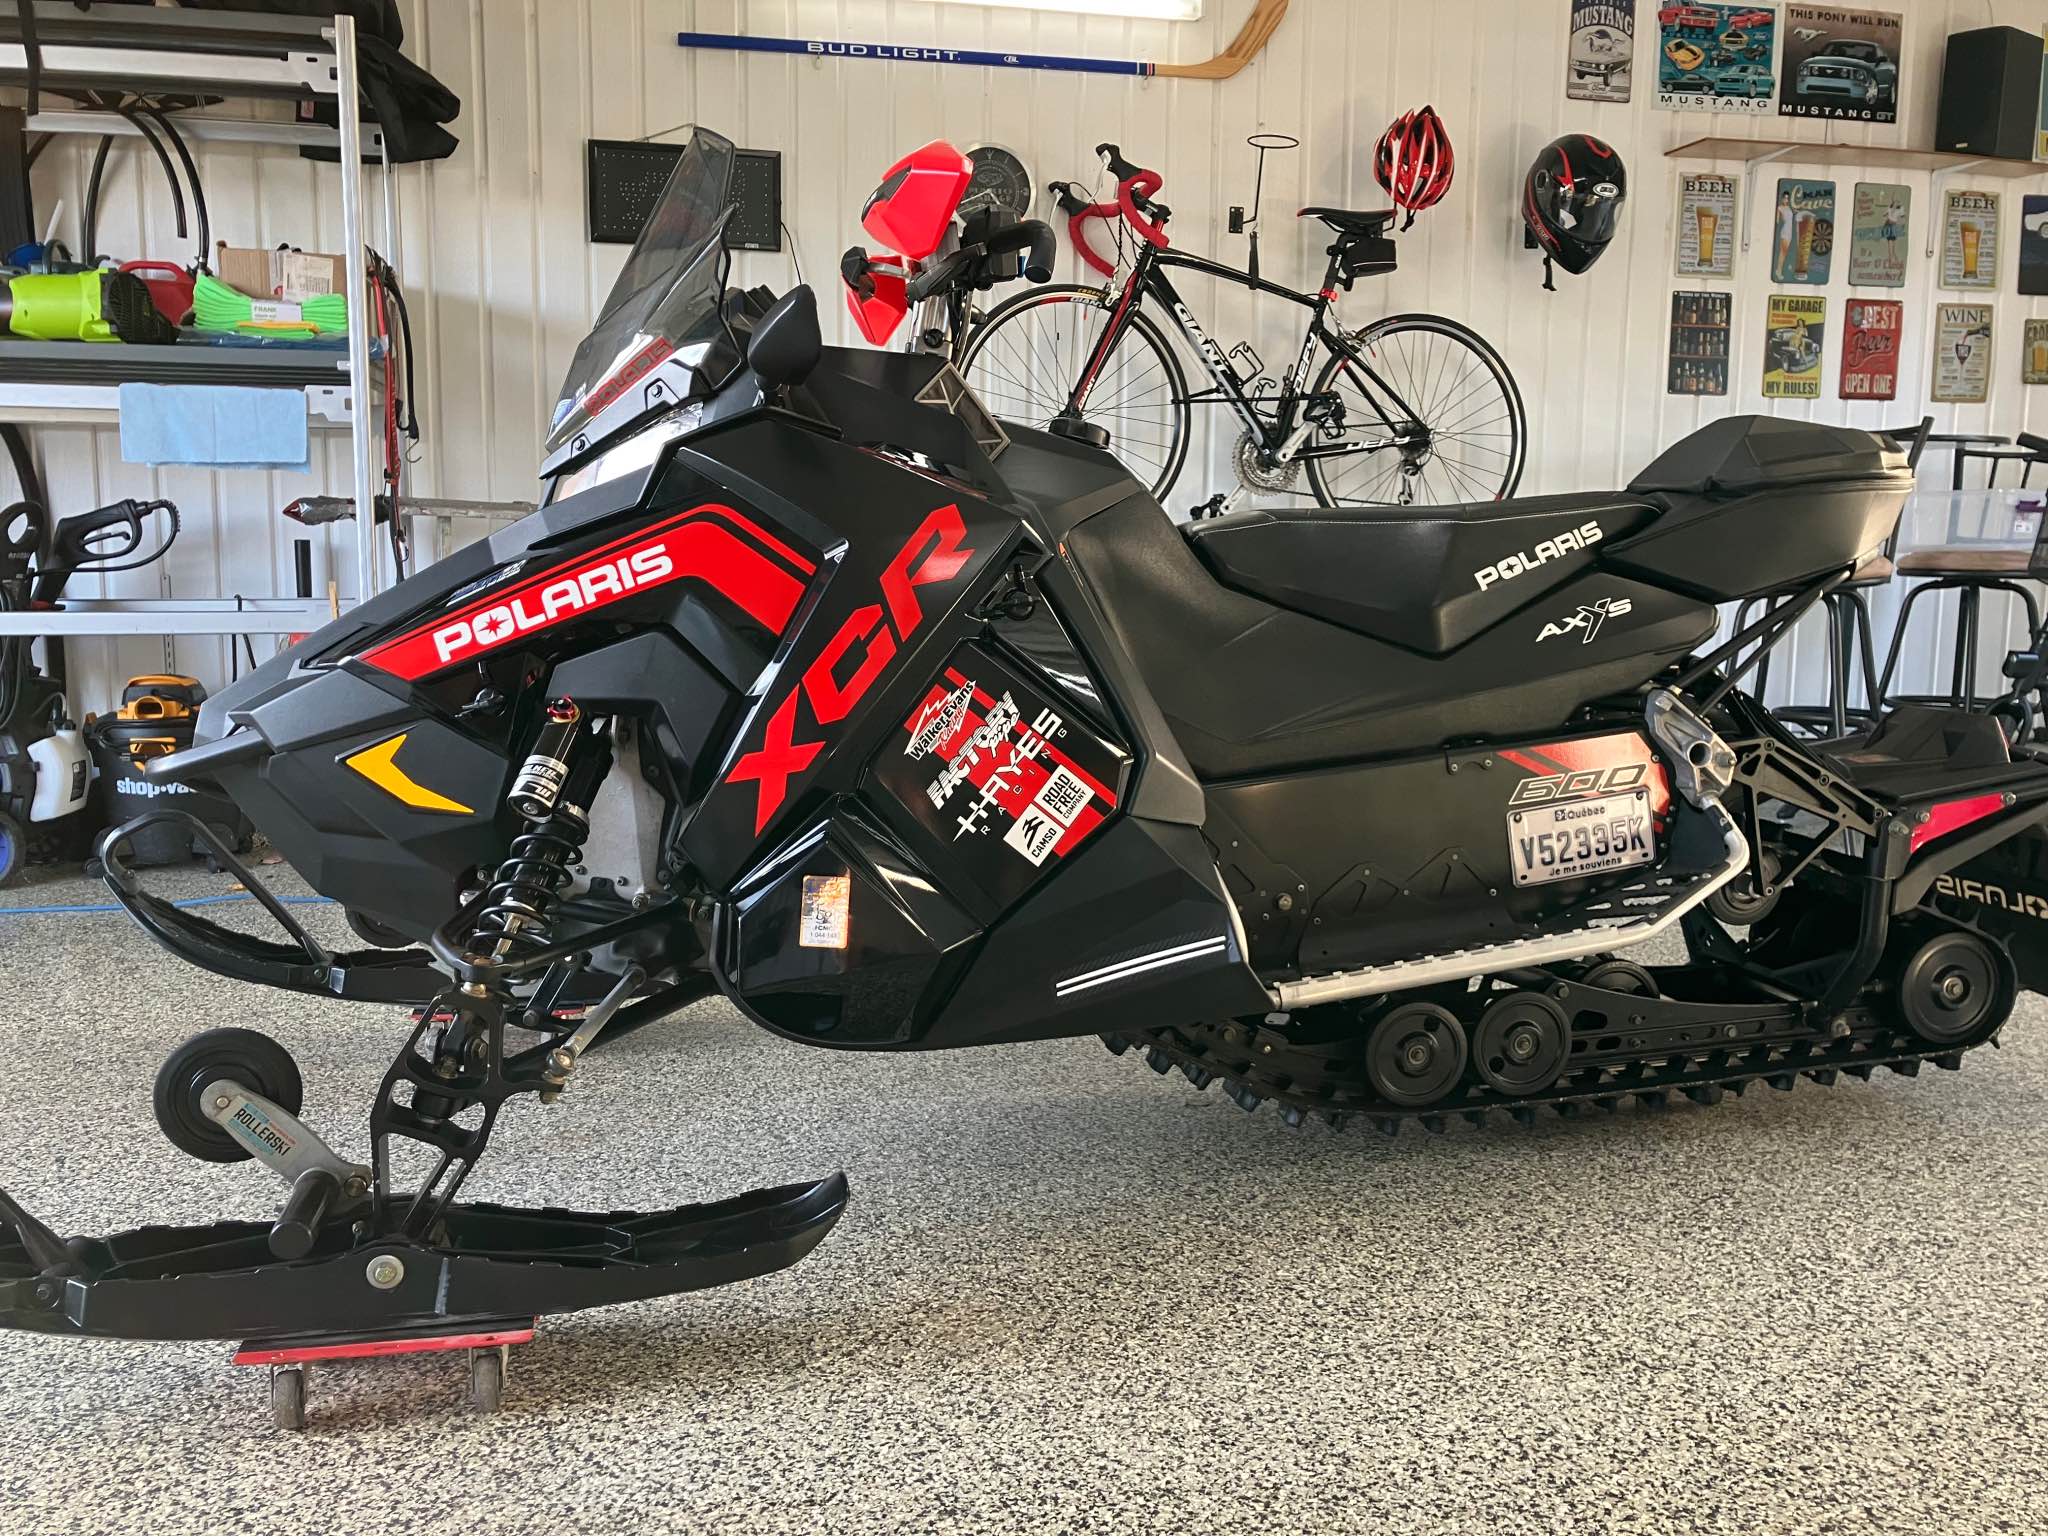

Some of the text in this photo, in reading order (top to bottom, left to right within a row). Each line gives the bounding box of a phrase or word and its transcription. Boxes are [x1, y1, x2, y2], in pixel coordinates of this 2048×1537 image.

[1573, 5, 1633, 35] MUSTANG
[1790, 9, 1899, 28] THIS PONY WILL RUN
[807, 42, 959, 61] BUD LIGHT
[1661, 95, 1768, 108] MUSTANG
[1782, 104, 1894, 121] MUSTANG GT
[1685, 181, 1733, 194] BEER
[1790, 184, 1833, 210] Cave
[1951, 196, 1995, 209] BEER
[1772, 298, 1823, 313] MY GARAGE
[1864, 305, 1899, 330] BEST
[1945, 309, 1987, 323] WINE
[1174, 301, 1232, 377] GIANT
[586, 340, 670, 412] POLARIS
[1293, 332, 1317, 394] DEFY
[1077, 376, 1096, 411] GIANT
[1766, 381, 1818, 395] MY RULES!
[1845, 373, 1893, 394] OPEN ONE
[1474, 520, 1604, 592] POLARIS
[432, 543, 673, 663] POLARIS
[1535, 597, 1632, 644] AXYS
[725, 503, 976, 838] XCR
[910, 680, 975, 760] Walker Evans
[926, 690, 1020, 810] FACTORY
[953, 707, 1062, 842] HAYES
[1042, 773, 1071, 806] ROAD
[1509, 763, 1648, 805] 600
[1053, 781, 1081, 815] FREE
[1063, 790, 1087, 819] COMPANY
[1567, 806, 1606, 819] Québec
[1031, 827, 1057, 858] CAMSO
[1520, 816, 1646, 870] V52335K
[1549, 856, 1622, 876] Je me souviens
[233, 1108, 291, 1156] ROLLERSKI
